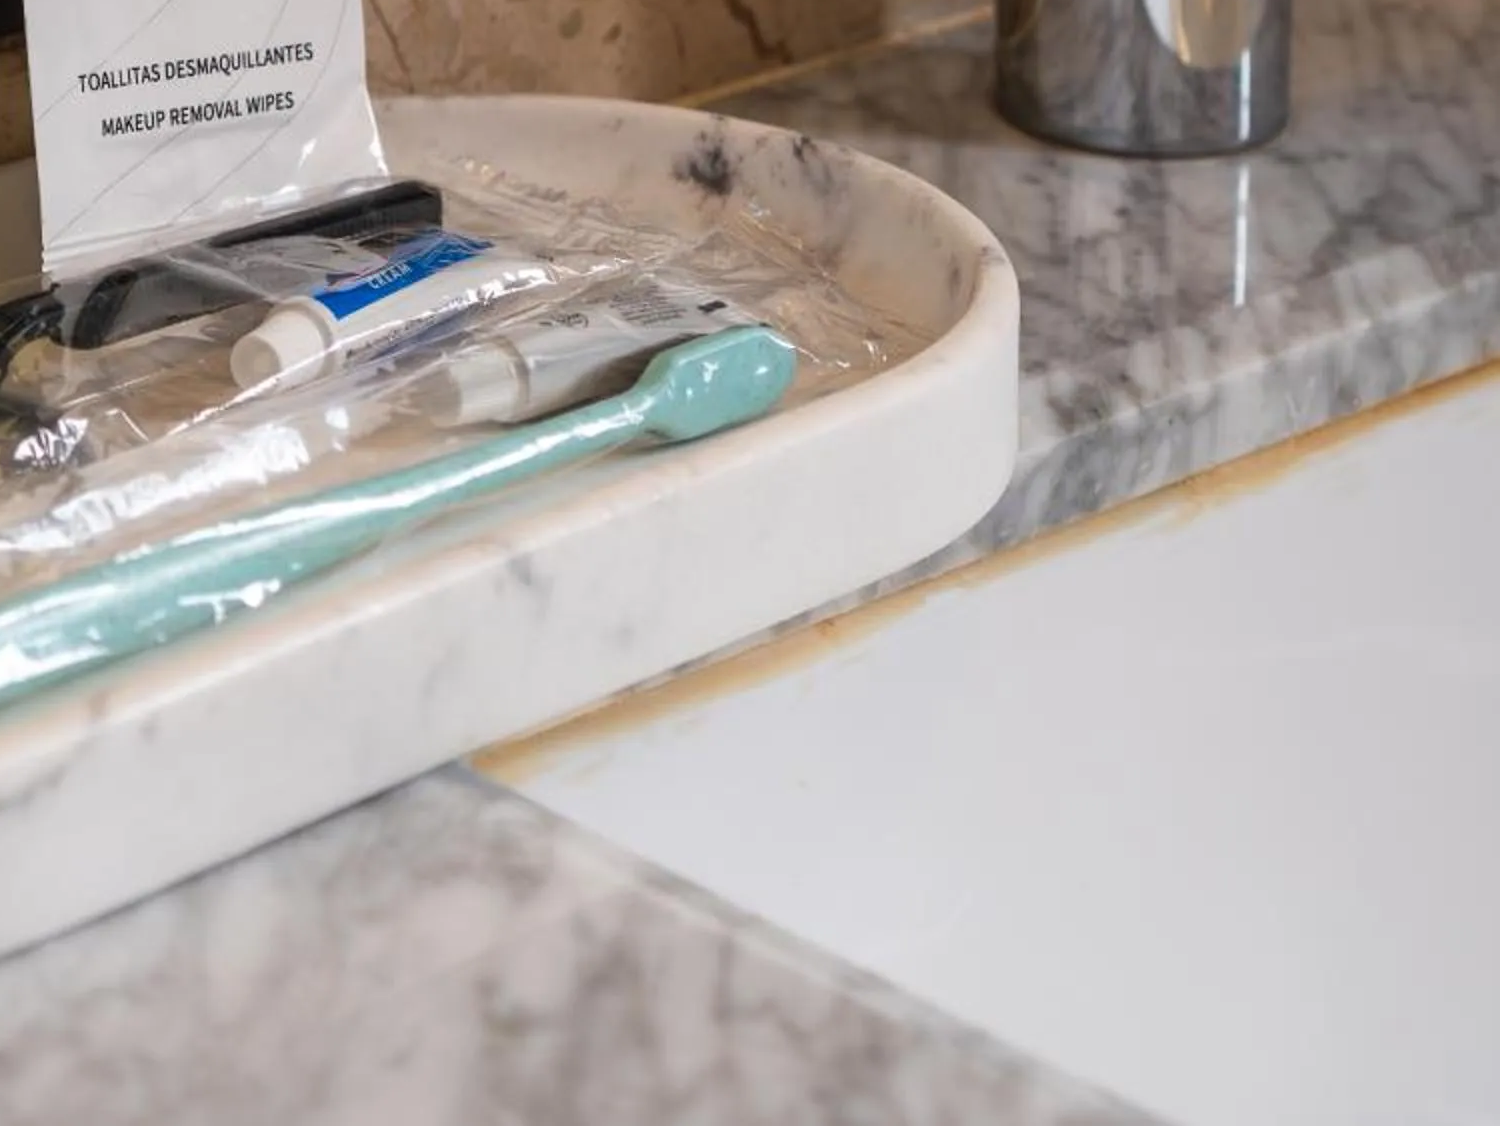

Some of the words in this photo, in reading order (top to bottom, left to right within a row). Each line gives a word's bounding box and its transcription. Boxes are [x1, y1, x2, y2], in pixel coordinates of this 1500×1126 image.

[78, 63, 161, 93] TOALLITAS
[164, 42, 314, 81] DESMAQUILLANTES
[101, 110, 165, 137] MAKEUP
[170, 100, 242, 126] REMOVAL
[245, 91, 294, 114] WIPES
